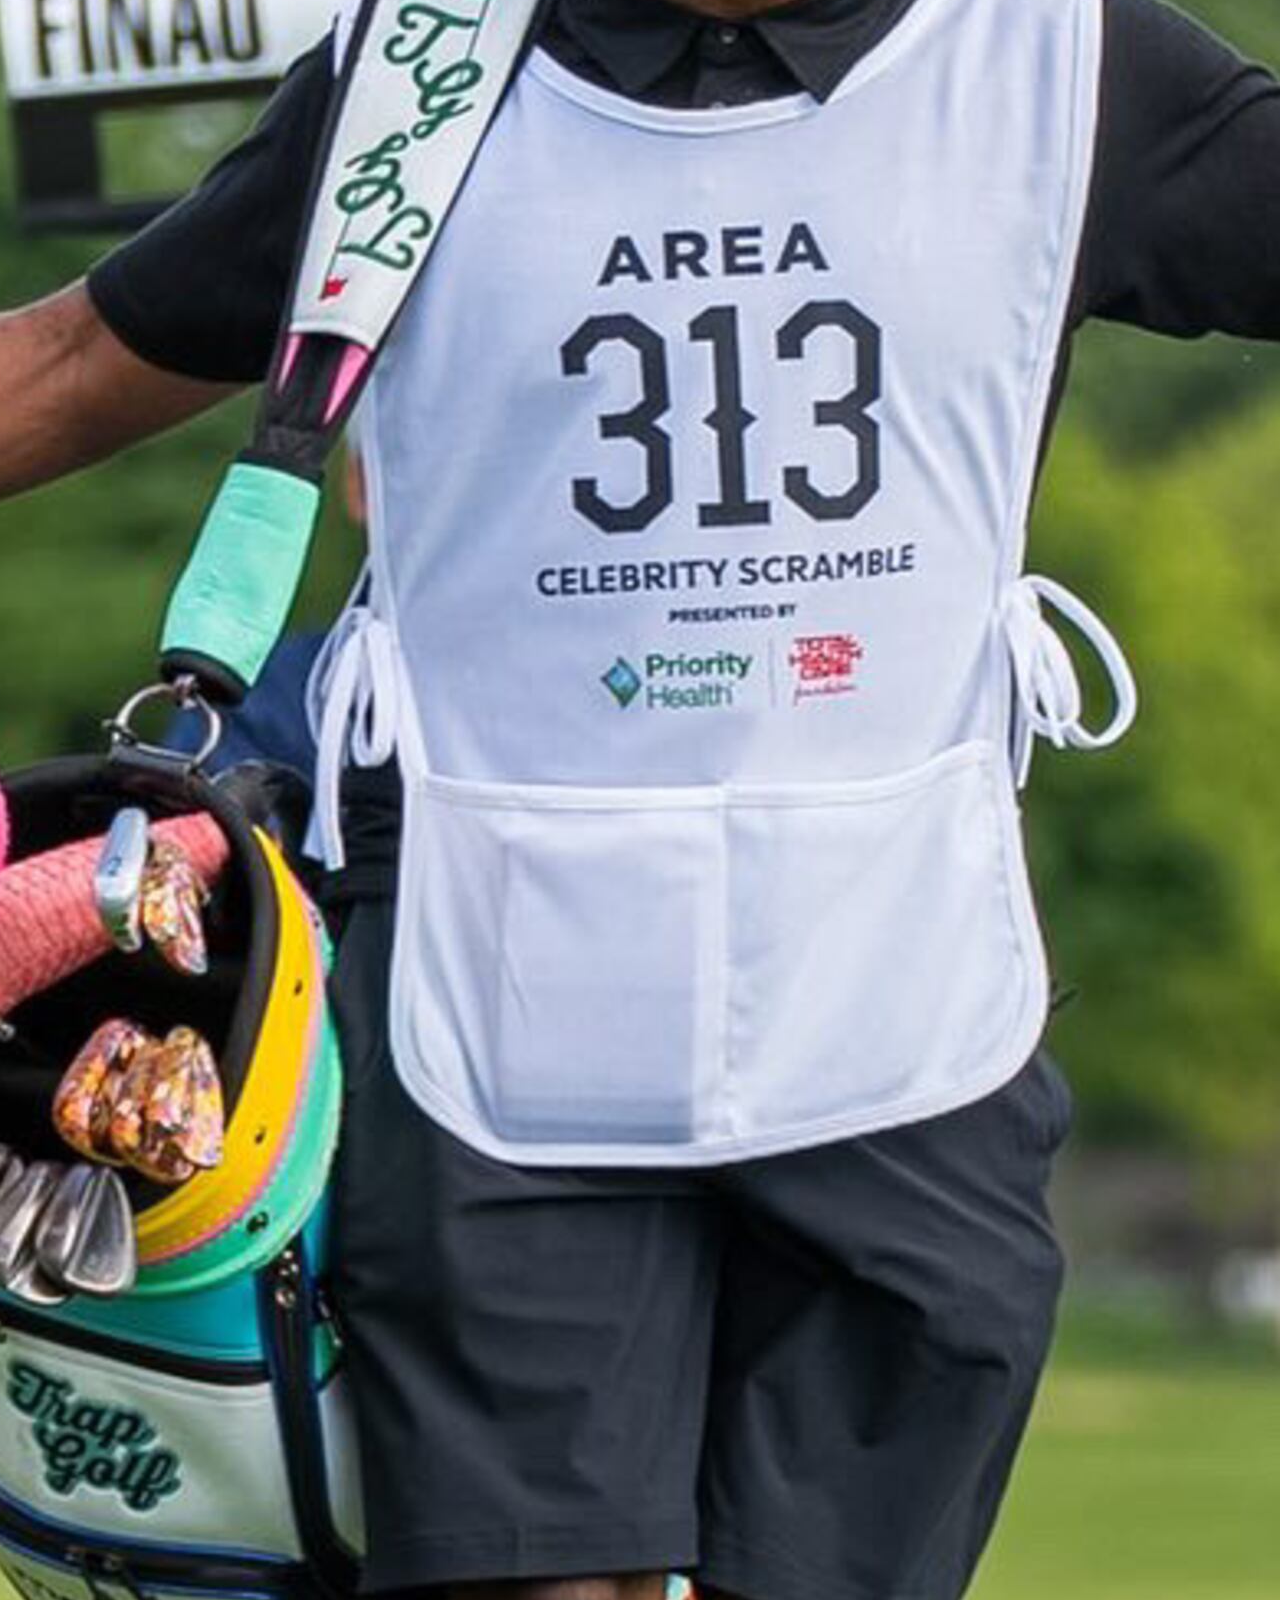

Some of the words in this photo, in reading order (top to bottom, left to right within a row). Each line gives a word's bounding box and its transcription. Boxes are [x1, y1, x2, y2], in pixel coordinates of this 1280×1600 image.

[597, 222, 830, 286] AREA
[560, 299, 882, 534] 313
[536, 558, 728, 596] CELEBRITY
[738, 543, 915, 586] SCRAMBLE
[668, 604, 775, 623] PRESENTED
[777, 604, 797, 618] BY
[646, 651, 753, 679] Priority
[646, 683, 733, 709] Health
[8, 1359, 156, 1448] Trap
[33, 1422, 182, 1512] Golf
